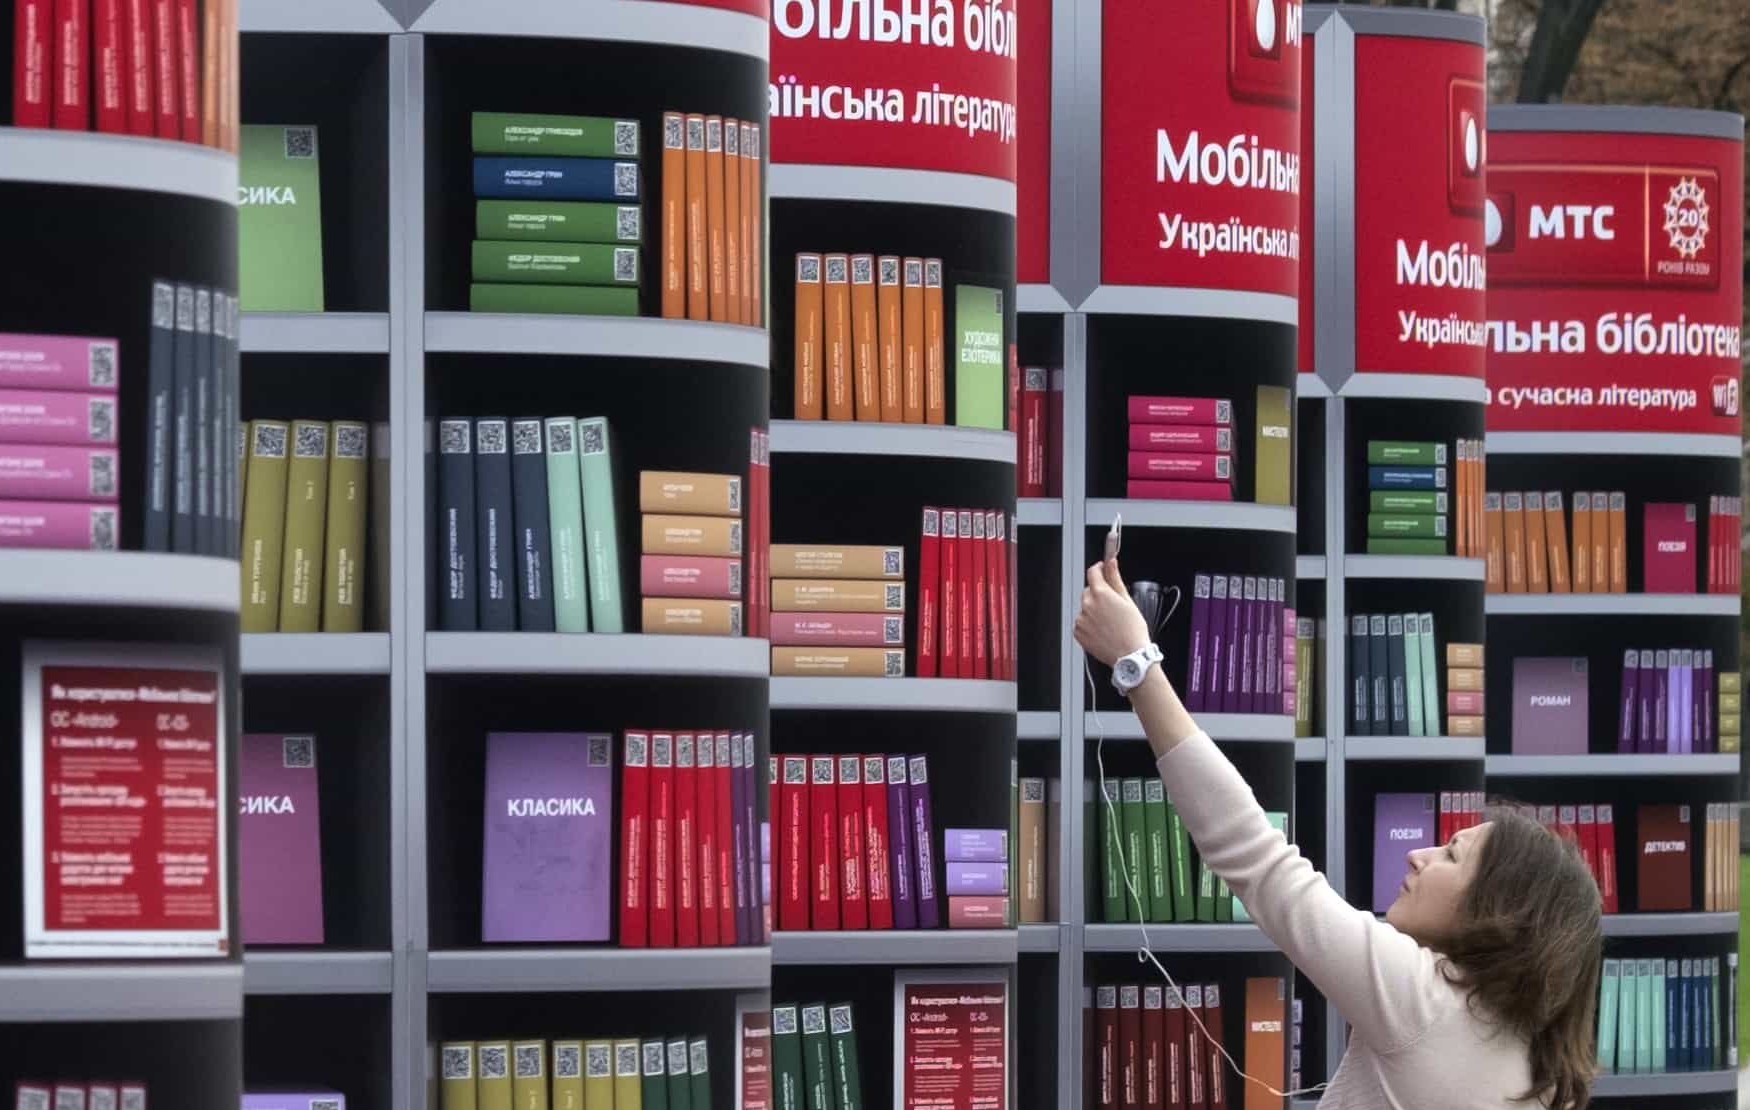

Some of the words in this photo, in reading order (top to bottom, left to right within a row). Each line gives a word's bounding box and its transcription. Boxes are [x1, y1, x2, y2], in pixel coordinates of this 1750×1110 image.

[1529, 205, 1615, 240] МТС
[1678, 209, 1698, 226] 20
[1158, 213, 1287, 258] Українська
[1597, 312, 1740, 358] бібліотека
[1499, 387, 1592, 410] сучасна
[1598, 383, 1697, 411] література
[1530, 696, 1571, 707] РОМАН
[507, 798, 596, 816] КЛАСИКА
[1390, 828, 1423, 842] ПОЕЗІЯ
[1644, 841, 1686, 855] ДЕТЕКТИВ
